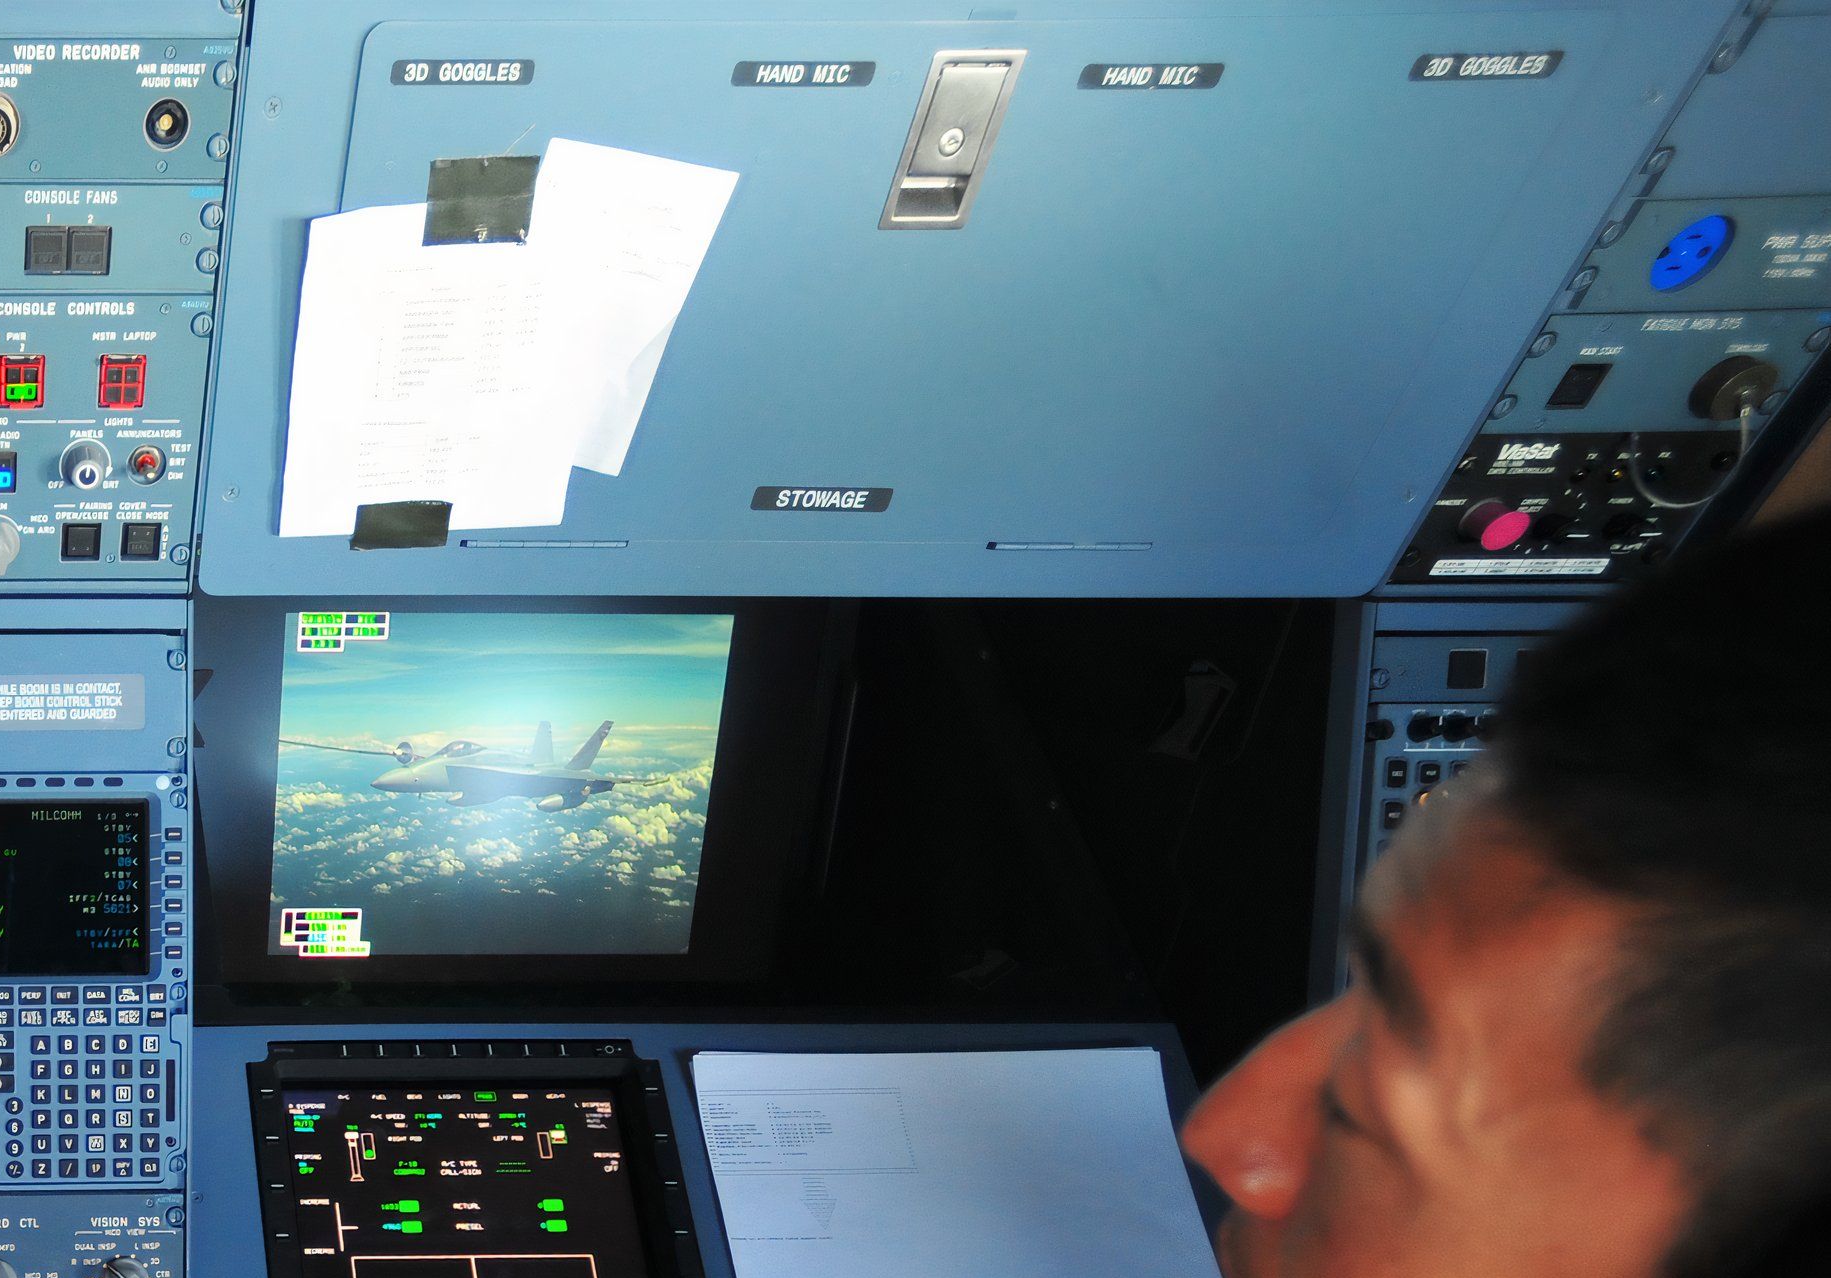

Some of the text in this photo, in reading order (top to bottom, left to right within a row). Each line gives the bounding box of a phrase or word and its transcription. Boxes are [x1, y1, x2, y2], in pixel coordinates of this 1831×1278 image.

[13, 45, 140, 60] VIDEO RECORDER
[1423, 56, 1550, 77] 3D GOGGLES
[403, 63, 521, 82] 3D GOGGLES
[756, 64, 851, 83] HAND MIC
[1102, 67, 1200, 85] HAND MIC
[142, 77, 199, 88] AUDIO ONLY
[24, 190, 118, 205] CONSOLE FANS
[87, 214, 94, 224] 2
[68, 303, 135, 315] CONTROLS
[123, 332, 156, 341] LAPTOP
[105, 417, 133, 426] LIGHTS
[70, 430, 103, 438] PANELS
[171, 444, 191, 452] TEST
[1497, 443, 1562, 460] ViaSat
[776, 490, 869, 508] STOWAGE
[80, 502, 146, 510] FAIRING COVER
[56, 512, 108, 520] OPEN/CLOSE
[116, 512, 169, 520] CLOSE MODE
[20, 684, 48, 695] BOOM
[51, 684, 60, 694] IS
[63, 683, 74, 694] IN
[76, 683, 121, 694] CONTACT,
[15, 696, 44, 708] BOOM
[46, 696, 91, 707] CONTROL
[95, 696, 122, 707] STICK
[47, 709, 67, 720] AND
[70, 709, 116, 720] GUARDED
[31, 811, 82, 820] MILCOMM
[37, 1039, 100, 1050] A B C
[37, 1064, 100, 1075] F G H
[37, 1089, 45, 1100] K
[12, 1101, 18, 1112] 3
[38, 1113, 154, 1125] P R T
[20, 1218, 39, 1228] CTL
[91, 1217, 160, 1227] VISION SYS
